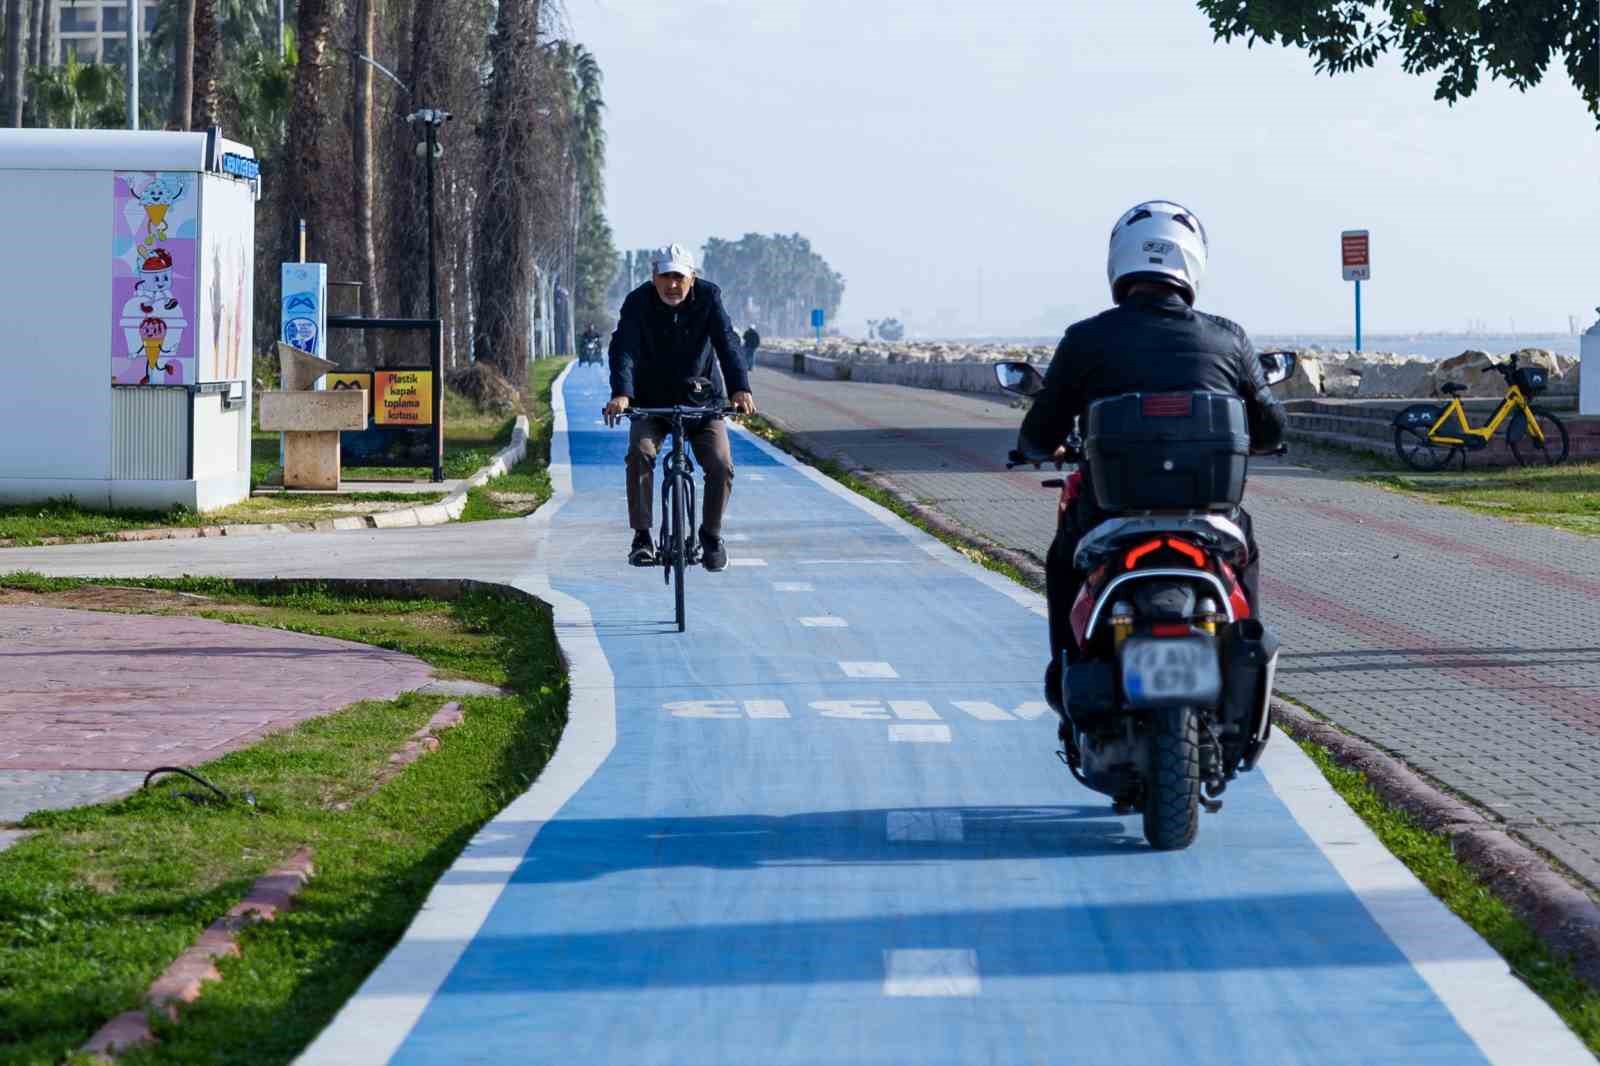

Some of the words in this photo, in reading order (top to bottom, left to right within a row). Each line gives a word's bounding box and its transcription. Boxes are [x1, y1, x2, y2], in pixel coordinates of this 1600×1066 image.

[388, 374, 418, 384] Plastik
[390, 385, 416, 397] kapak
[384, 397, 420, 409] toplama
[388, 409, 418, 420] kutusu
